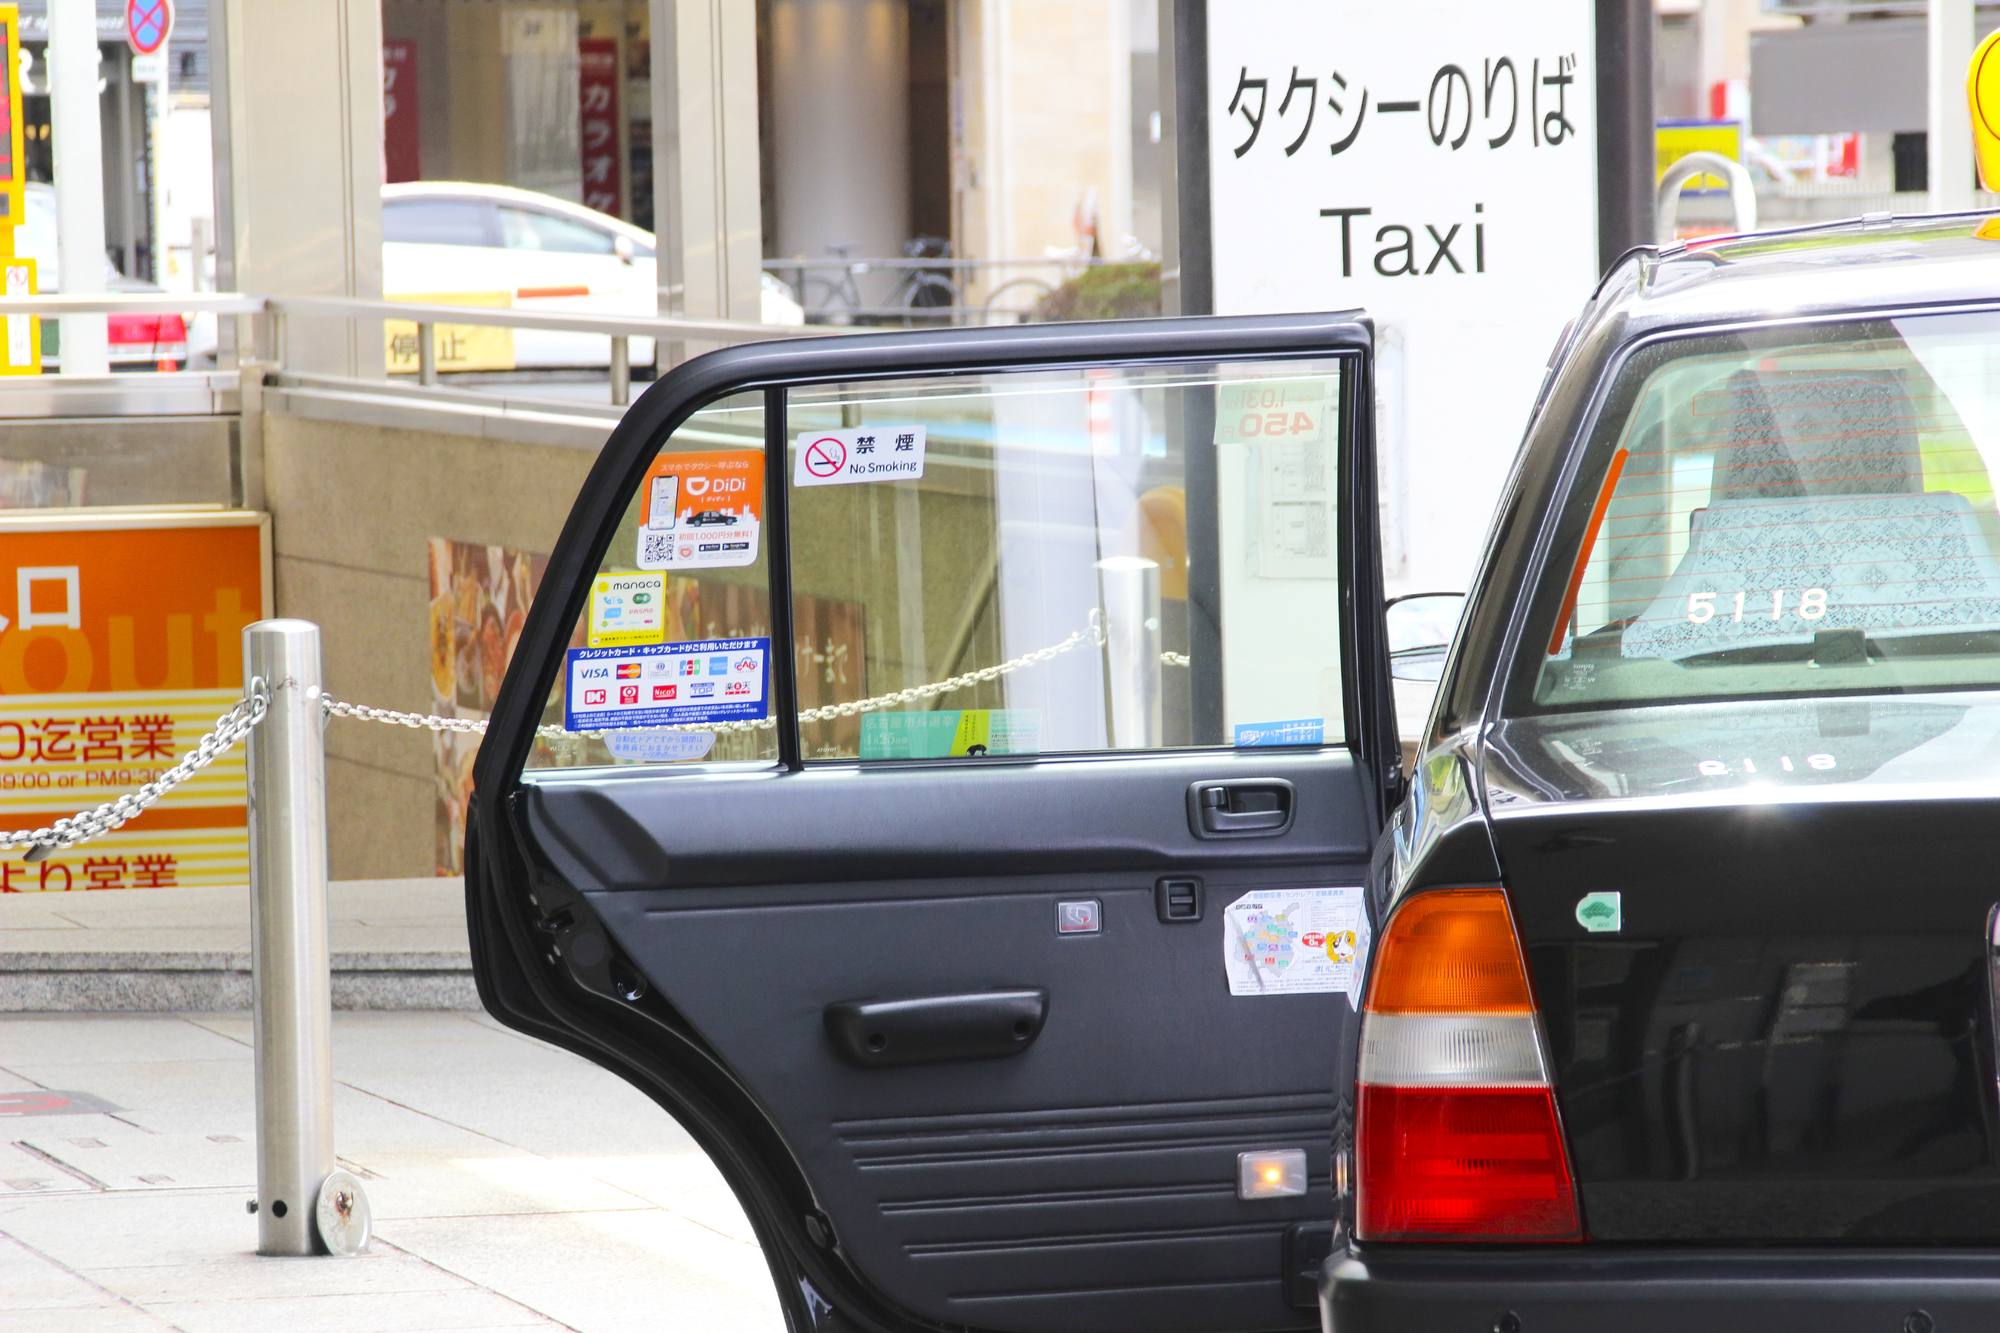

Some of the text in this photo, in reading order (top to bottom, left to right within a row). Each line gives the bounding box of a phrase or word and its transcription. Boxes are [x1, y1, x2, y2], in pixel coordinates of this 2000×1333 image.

[1228, 53, 1577, 158] タクシーのりば
[1319, 203, 1486, 278] Taxi
[850, 459, 918, 475] No Smoking
[712, 477, 747, 493] DiDi
[613, 580, 661, 591] manaca
[1687, 587, 1828, 624] 5118
[579, 640, 759, 659] クレジットカード・キャブカードがご利用いただけます
[580, 668, 609, 679] VISA
[679, 659, 701, 676] JCB
[585, 690, 605, 704] DC
[691, 686, 713, 695] TOP
[0, 772, 51, 790] 9:00
[58, 774, 78, 788] or
